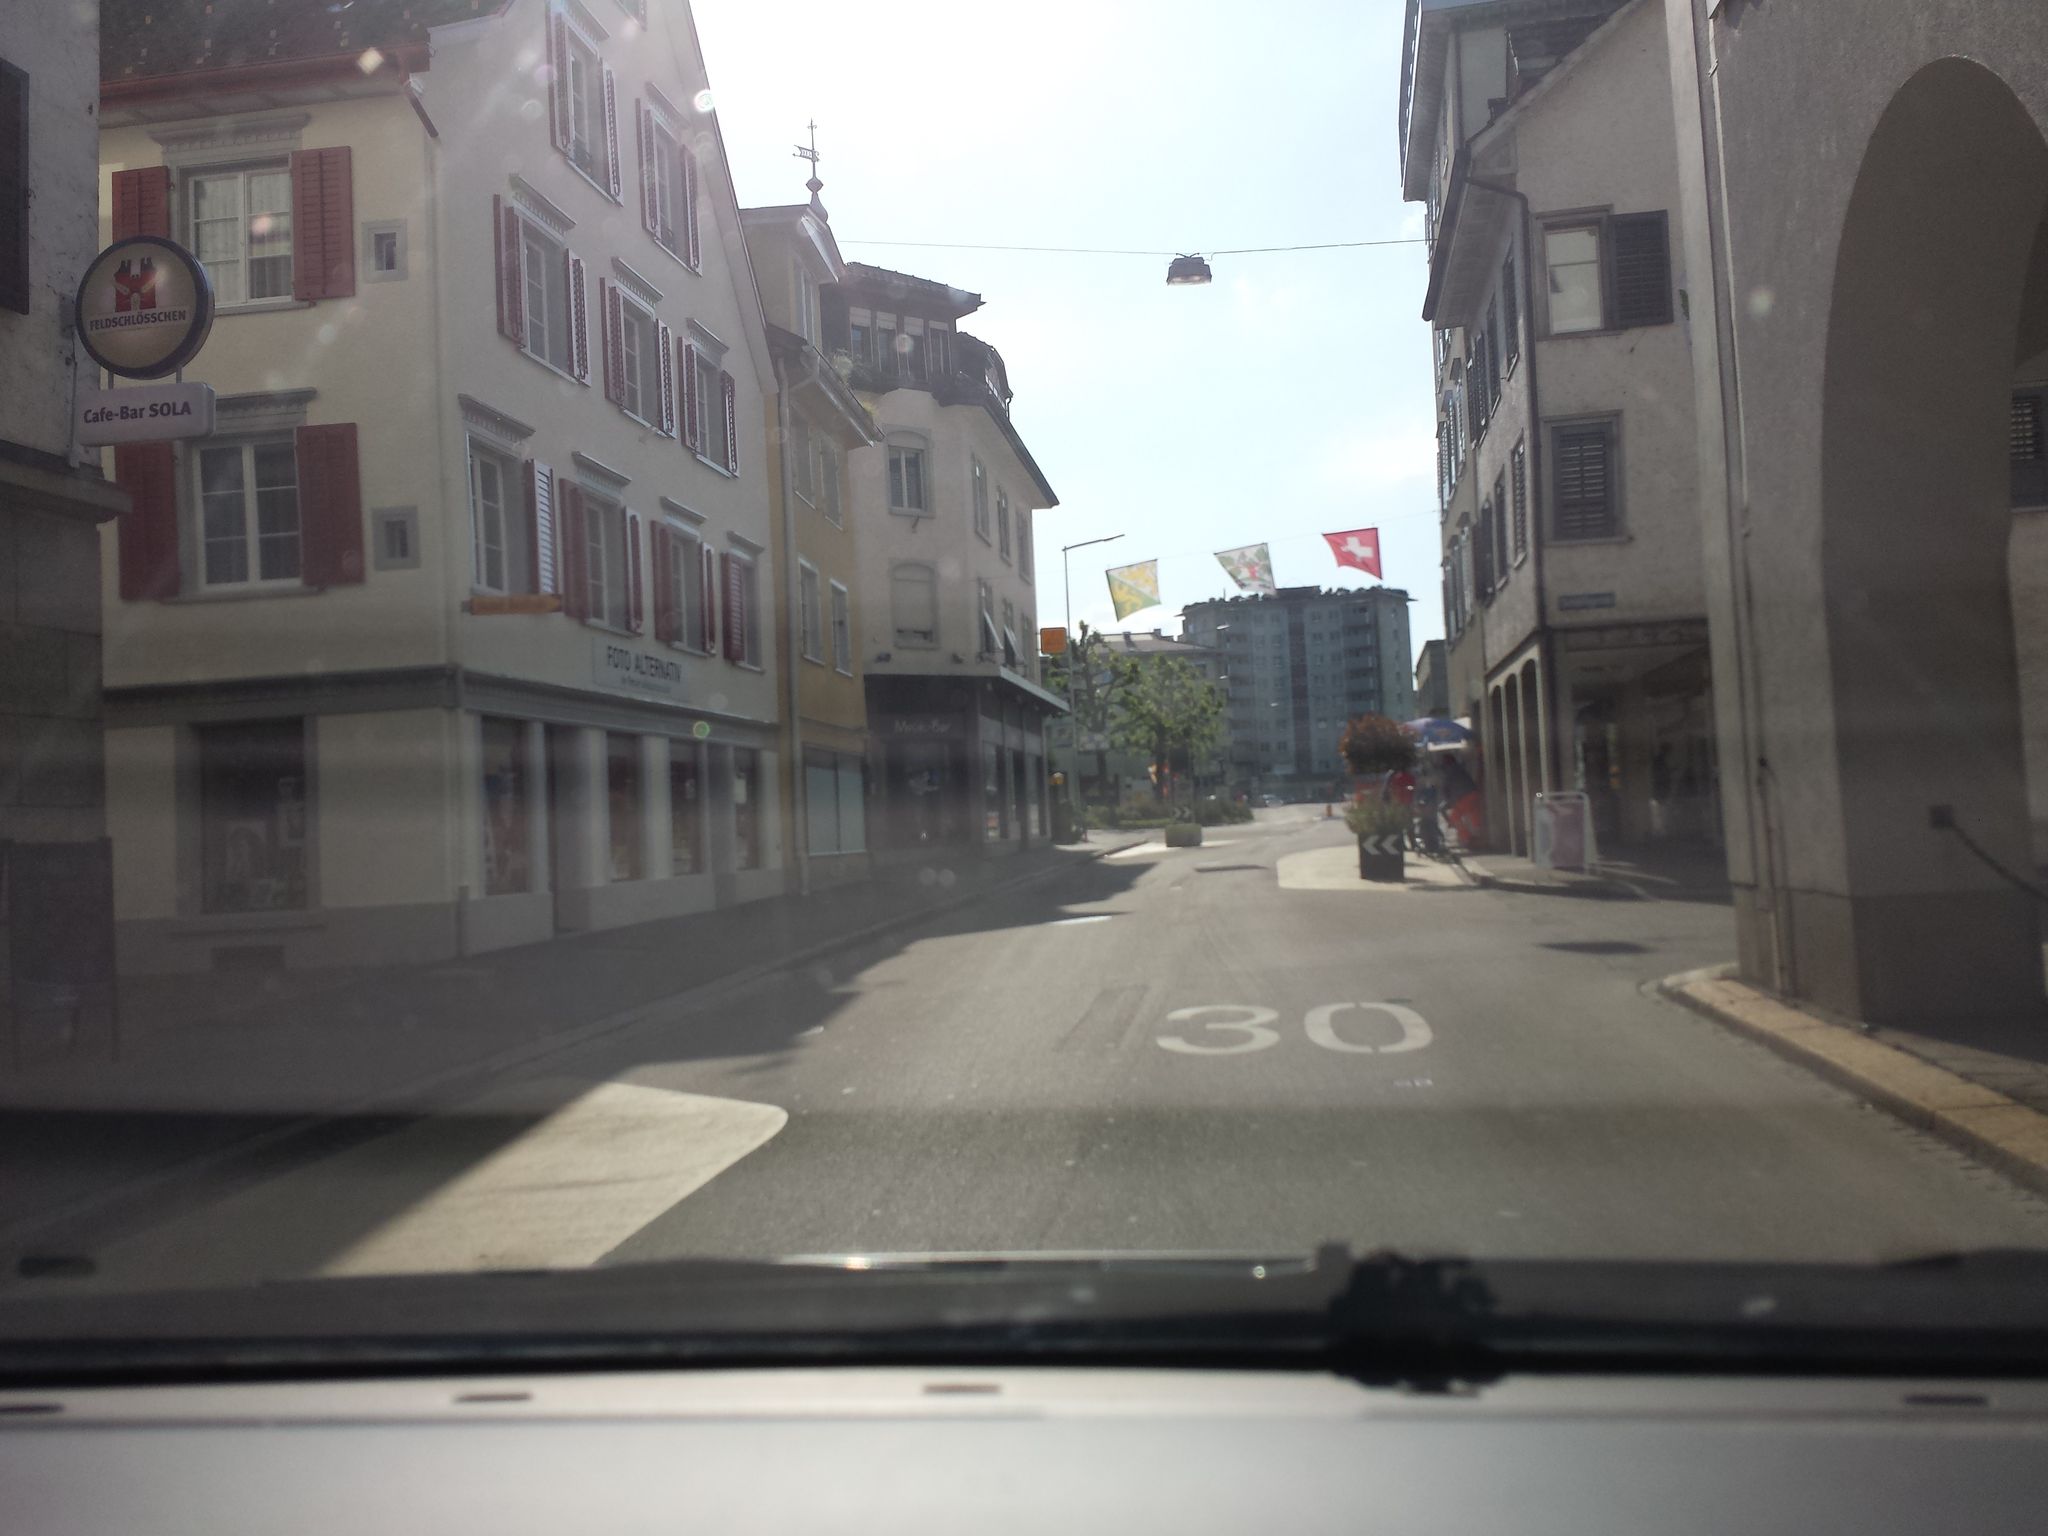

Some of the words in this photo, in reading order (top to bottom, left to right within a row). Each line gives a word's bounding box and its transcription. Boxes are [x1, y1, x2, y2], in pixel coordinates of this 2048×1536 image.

[90, 311, 186, 330] FELDSCHLÖSSCHEN
[84, 406, 145, 423] Cafe-Bar
[149, 402, 191, 417] SOLA
[607, 645, 632, 671] FOTO
[1156, 1002, 1434, 1054] 30
